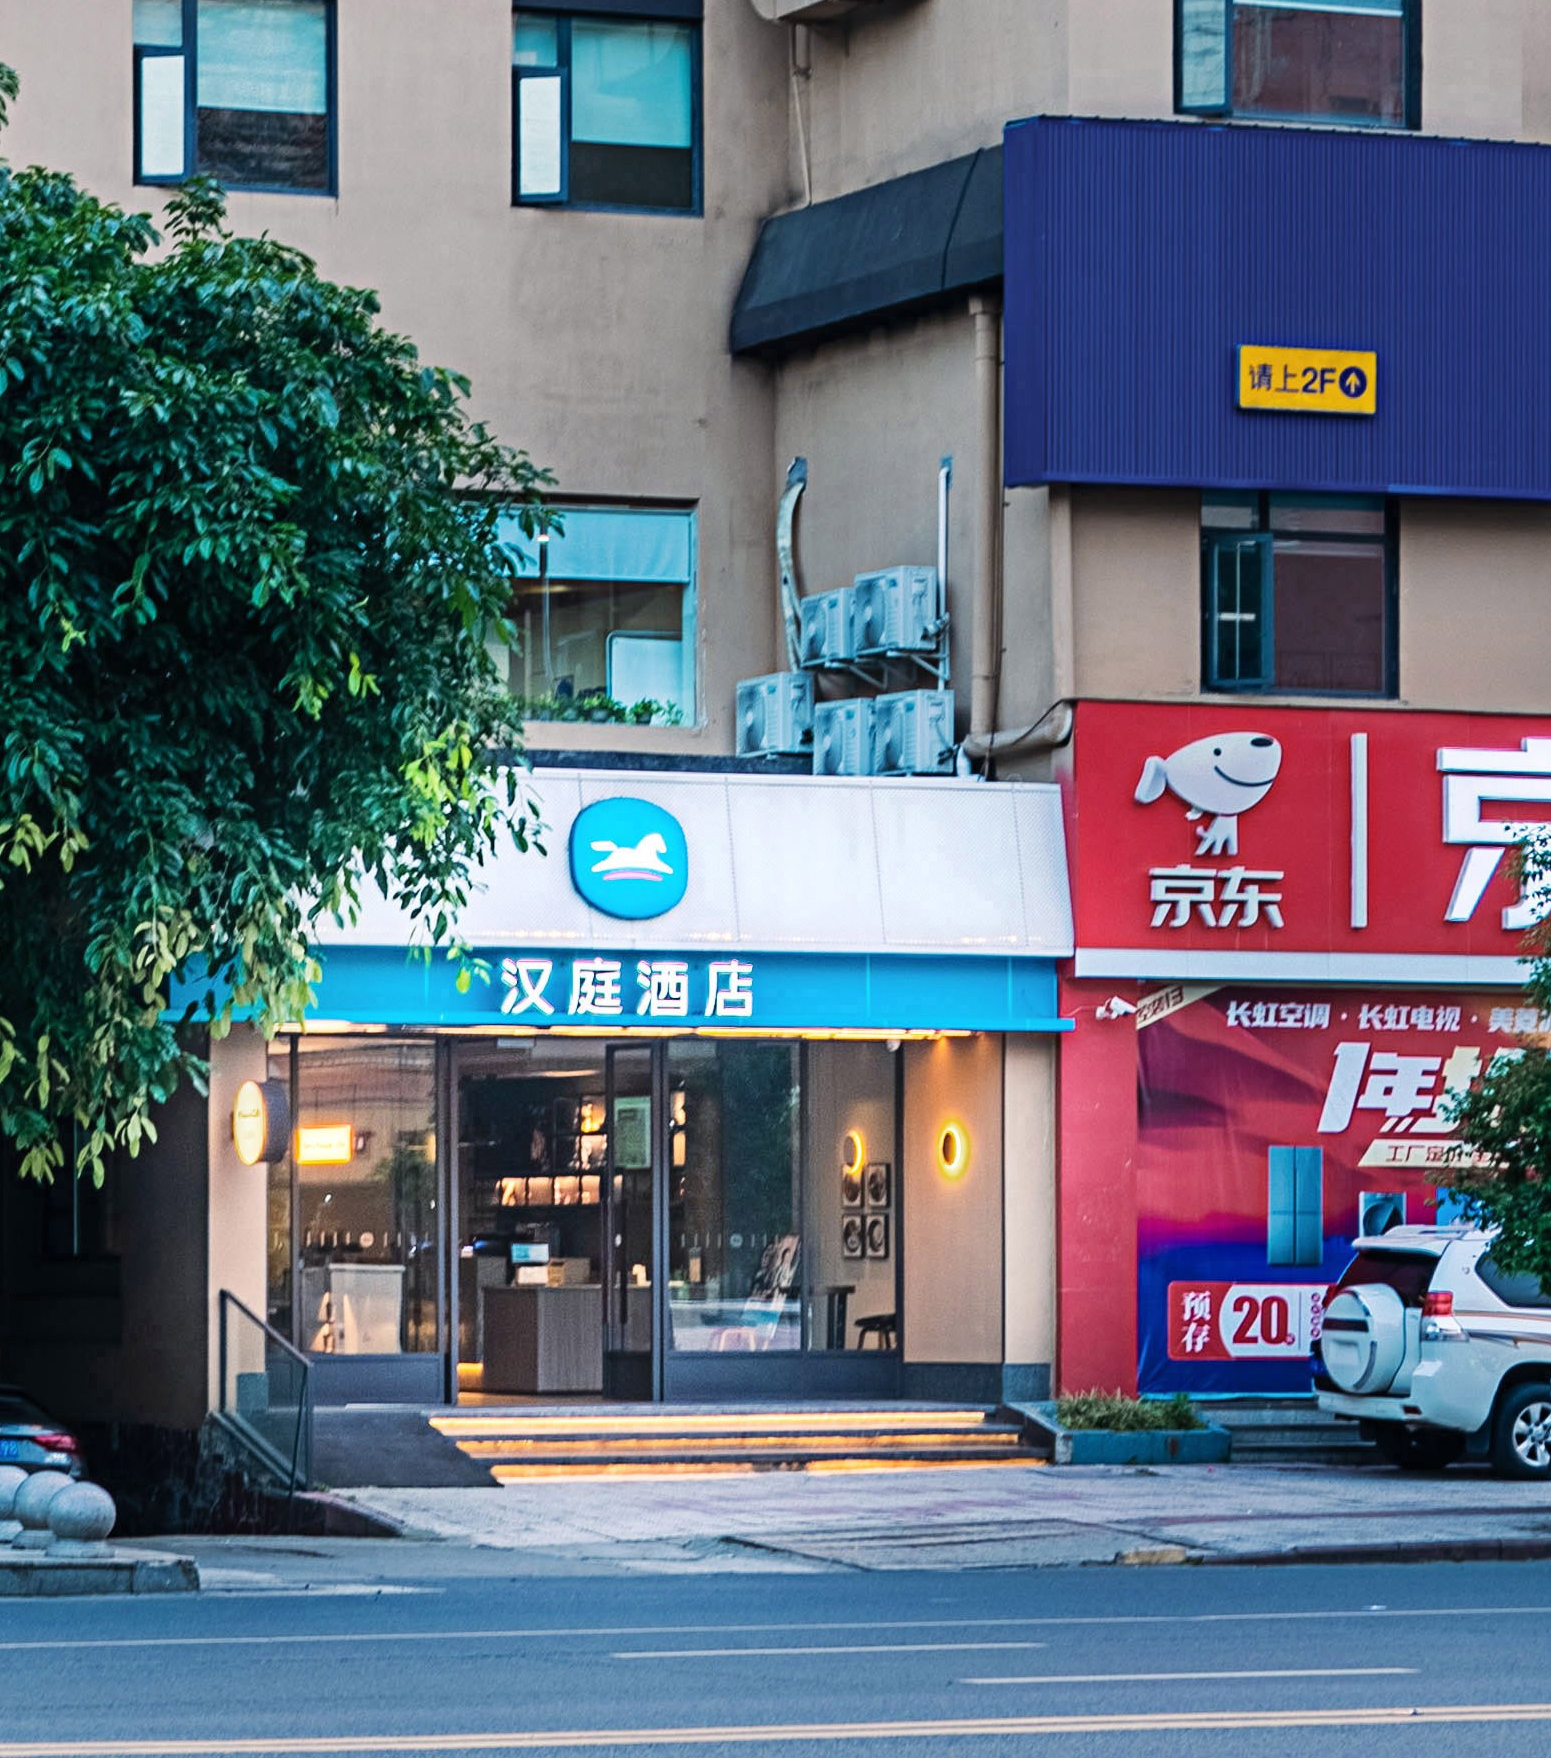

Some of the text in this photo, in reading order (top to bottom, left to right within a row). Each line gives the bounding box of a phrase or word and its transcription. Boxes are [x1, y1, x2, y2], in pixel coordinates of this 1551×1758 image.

[1249, 363, 1336, 393] 请上2F
[1148, 864, 1286, 928] 京东
[500, 957, 754, 1018] 汉庭酒店
